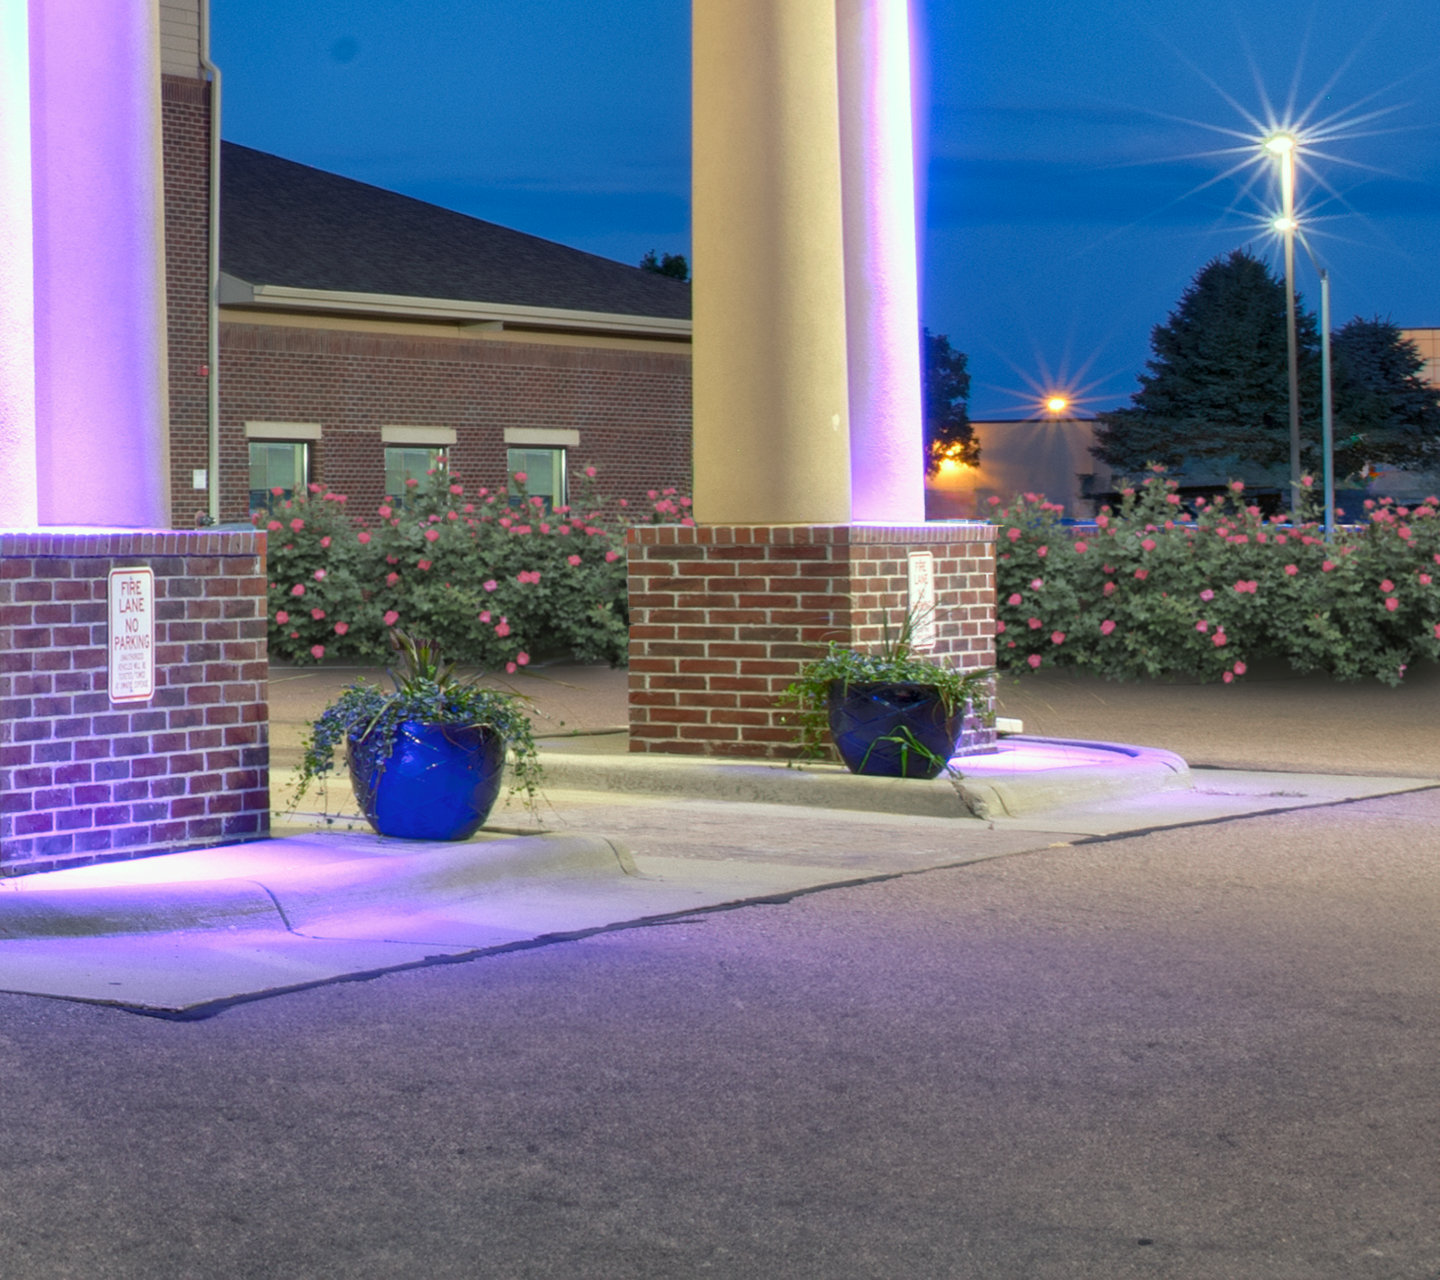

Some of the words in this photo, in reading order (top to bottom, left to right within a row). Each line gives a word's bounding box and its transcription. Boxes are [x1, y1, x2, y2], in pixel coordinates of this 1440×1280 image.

[120, 580, 142, 595] FIRE
[119, 597, 145, 613] LANE
[125, 618, 139, 633] NO
[114, 634, 150, 651] PARKING
